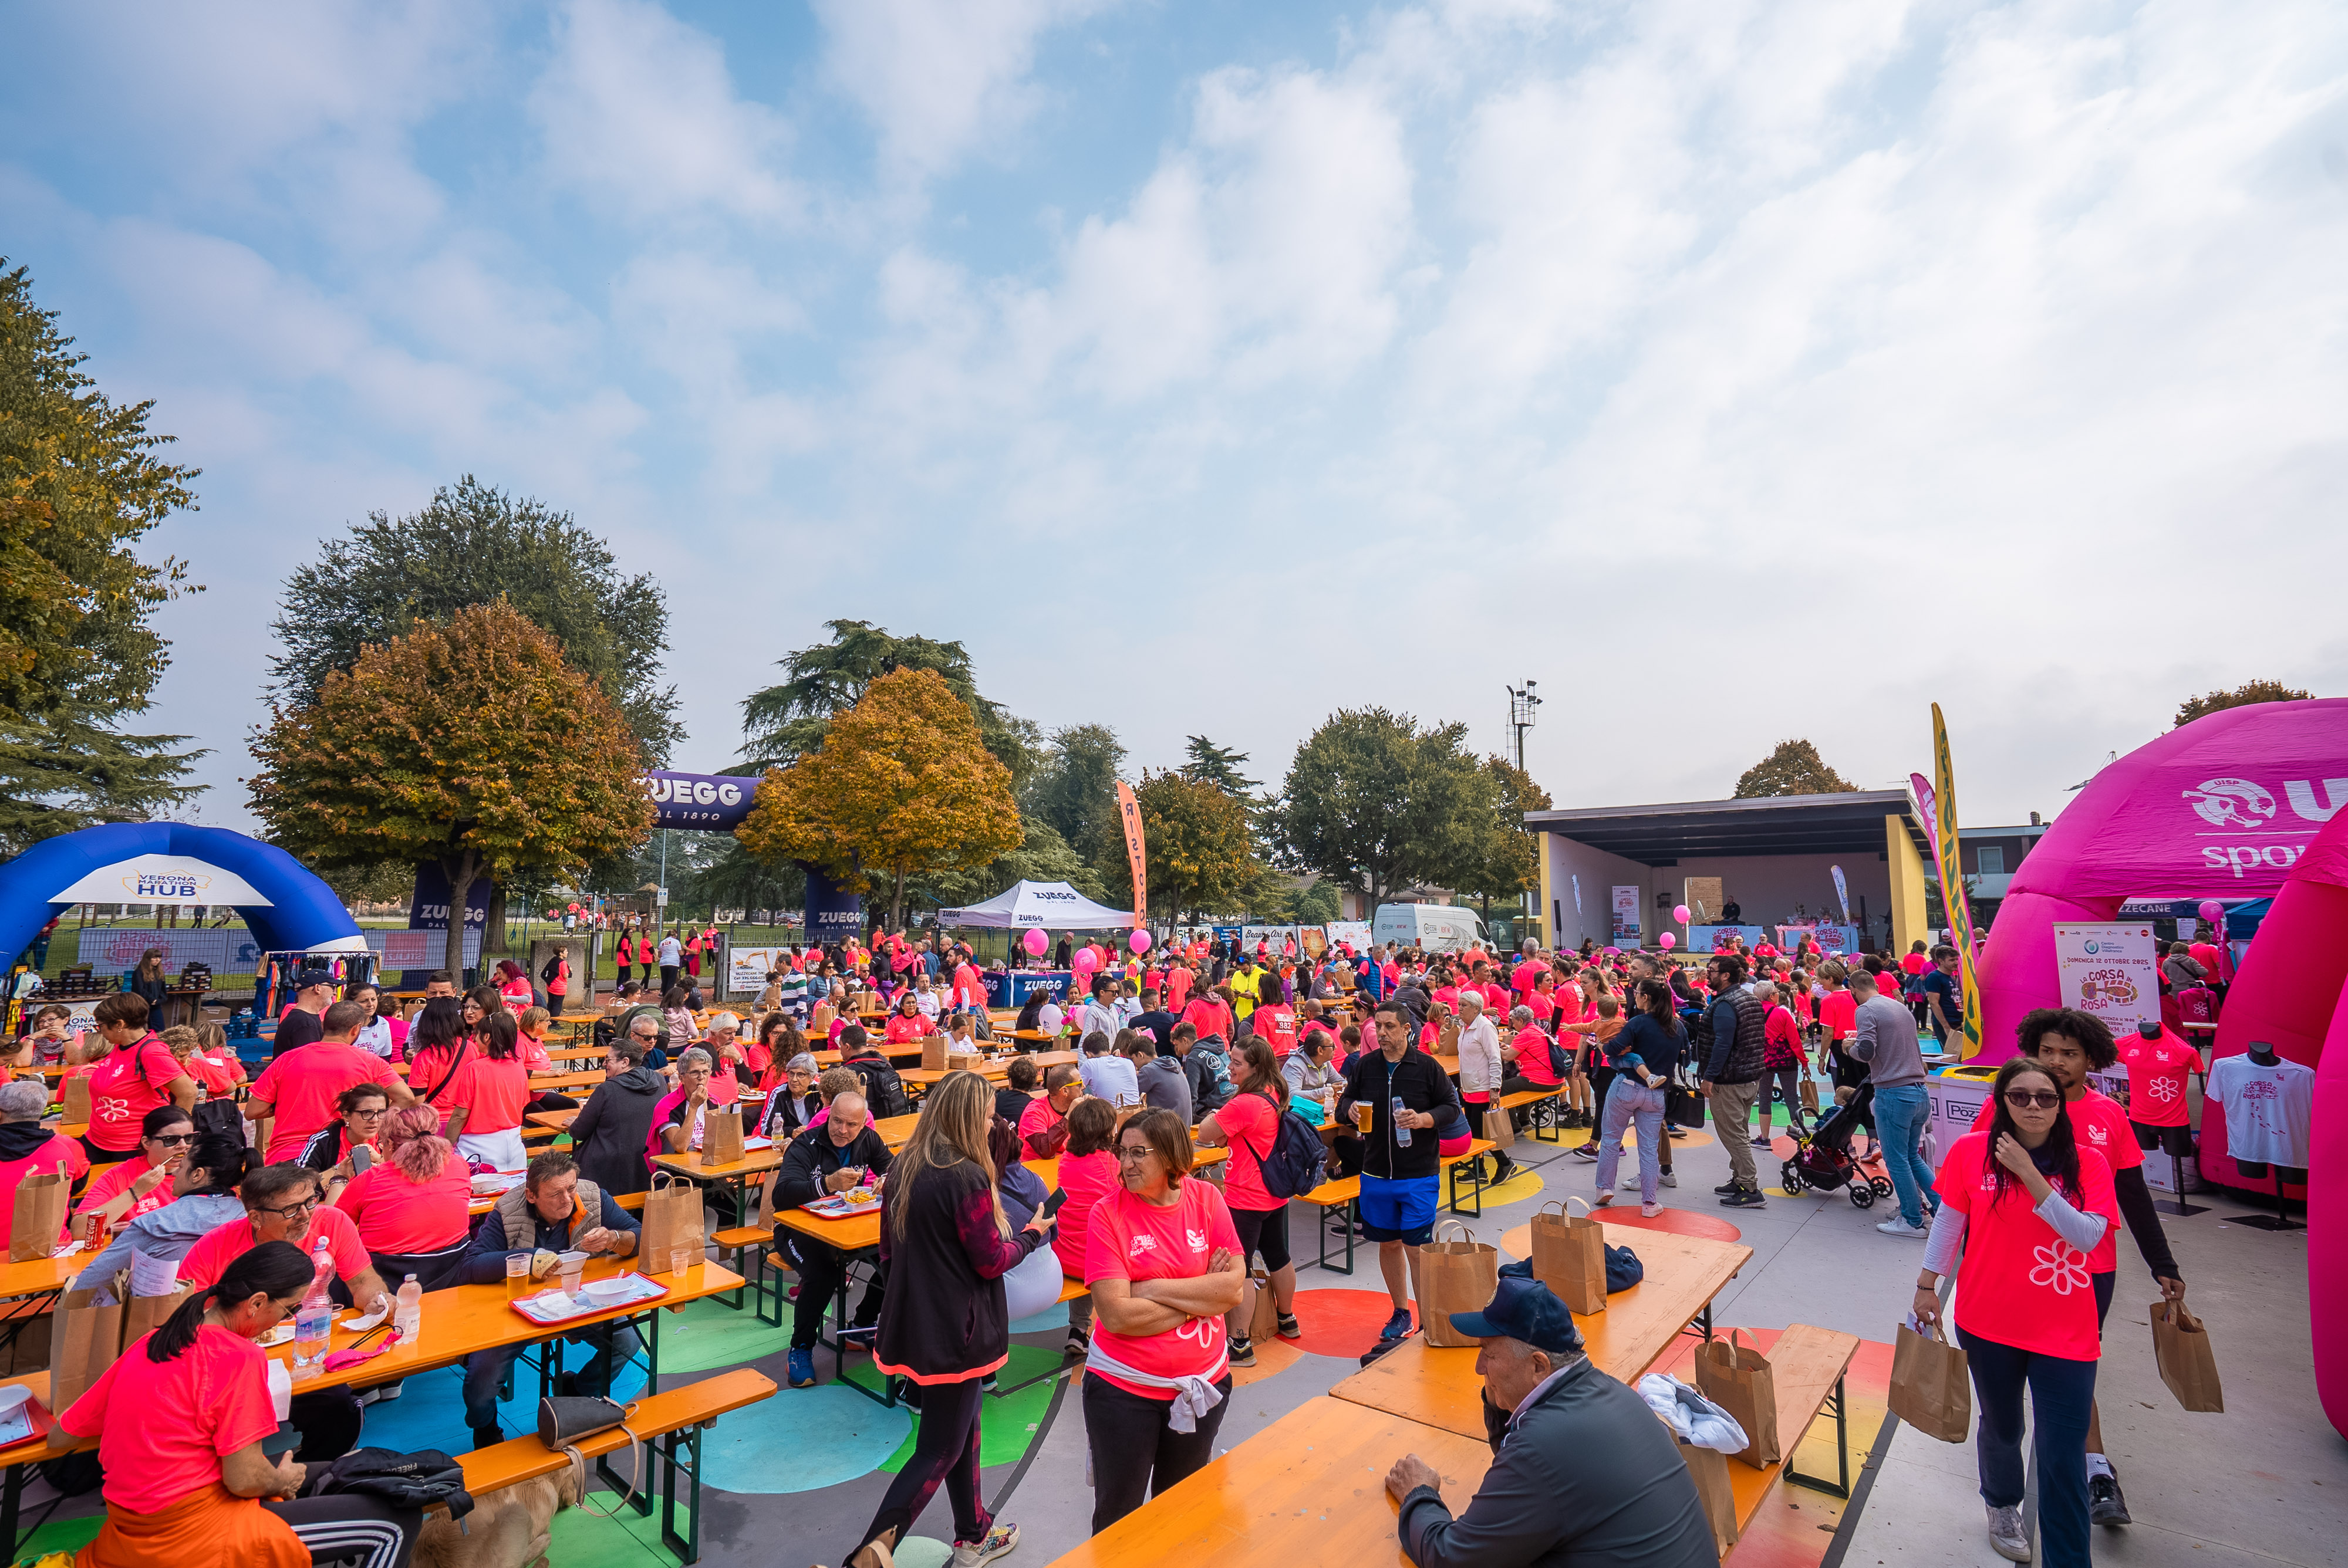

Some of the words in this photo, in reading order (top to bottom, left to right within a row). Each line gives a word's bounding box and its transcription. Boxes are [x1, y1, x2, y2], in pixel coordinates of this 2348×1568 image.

[640, 778, 742, 806] UEGG
[654, 810, 672, 819] AL
[683, 812, 720, 821] 1890
[137, 884, 196, 897] HUB
[1033, 891, 1077, 900] ZUEGG
[420, 904, 485, 922] ZUGG
[2119, 904, 2171, 913] ZZECANE
[818, 911, 861, 923] ZUEGG
[1245, 930, 1265, 938] Beaut
[1271, 930, 1283, 938] Art
[1815, 928, 1838, 936] CORSA
[2089, 969, 2124, 981] CORSA
[1024, 980, 1062, 991] ZUEGG
[2080, 998, 2109, 1011] ROSA
[1130, 1247, 1144, 1256] ROSA
